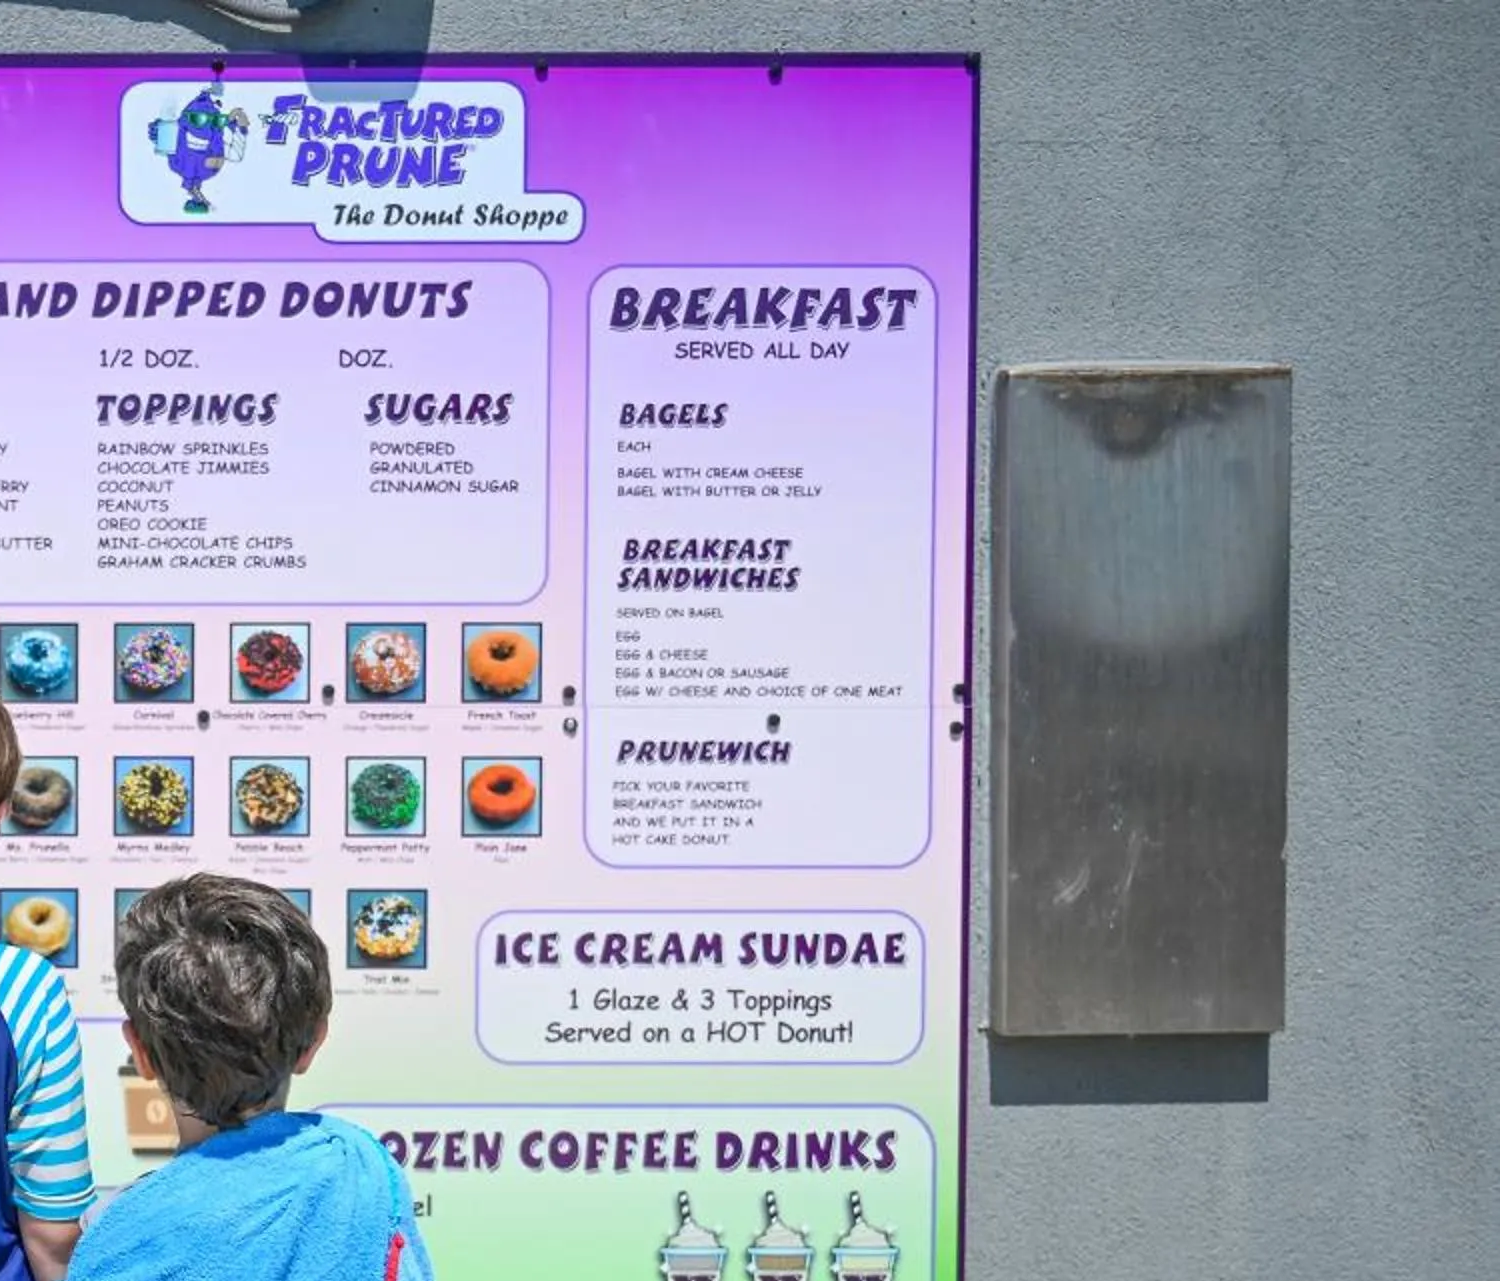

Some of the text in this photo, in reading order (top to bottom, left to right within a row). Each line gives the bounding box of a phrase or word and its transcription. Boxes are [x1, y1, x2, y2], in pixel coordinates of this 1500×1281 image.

[266, 94, 504, 144] FRACTURED
[292, 141, 467, 188] PRUNE
[334, 204, 568, 230] The Donut Shoppe
[92, 281, 266, 318] DIPPED
[280, 280, 473, 318] DONUTS
[610, 286, 917, 332] BREAKFAST
[100, 349, 198, 368] 1/2 DOZ.
[339, 349, 392, 368] DOZ.
[675, 341, 850, 360] SERVED ALL DAY
[97, 393, 278, 426] TOPPINGS
[364, 393, 512, 426] SUGARS
[620, 403, 728, 428] BAGELS
[97, 441, 269, 457] RAINBOW SPRINKLES
[369, 441, 456, 457] POWDERED
[617, 440, 652, 453] EACH
[97, 460, 271, 475] CHOCOLATE JIMMIES
[369, 459, 474, 475] GRANULATED
[617, 467, 805, 479] BAGEL WITH CREAM CHEESE
[96, 479, 175, 494] COCONUT
[369, 479, 520, 494] CINNAMON SUGAR
[617, 485, 822, 498] BAGEL WITH BUTTER OR JELLY
[97, 498, 170, 513] PEANUTS
[96, 516, 208, 532] OREO COOKIE
[98, 535, 293, 551] MINI-CHOCOLATE CHIPS
[623, 538, 791, 563] BREAKFAST
[169, 554, 237, 569] CRACKER
[243, 554, 307, 569] CRUMBS
[618, 567, 800, 591] SANDWICHES
[616, 607, 725, 619] SERVED ON BAGEL
[615, 630, 642, 643] EGG
[615, 648, 709, 661] EGG & CHEESE
[615, 666, 789, 679] EGG & BACON OR SAUSAGE
[615, 684, 903, 698] EGG W/ CHEESE AND CHOICE OF ONE MEAT
[618, 740, 791, 764] PRUNEWICH
[612, 780, 750, 793] PICK YOUR FAVORITE
[612, 797, 763, 811] BREAKFAST SANDWICH
[612, 815, 754, 828] AND WE PUT IT IN A
[612, 833, 641, 846] HOT
[645, 833, 677, 846] CAKE
[495, 932, 905, 967] ICE CREAM SUNDAE
[570, 988, 832, 1017] 1 Glaze & 3 Toppings
[545, 1021, 852, 1043] Served on a HOT Donut!
[379, 1130, 896, 1172] OZEN COFFEE DRINKS
